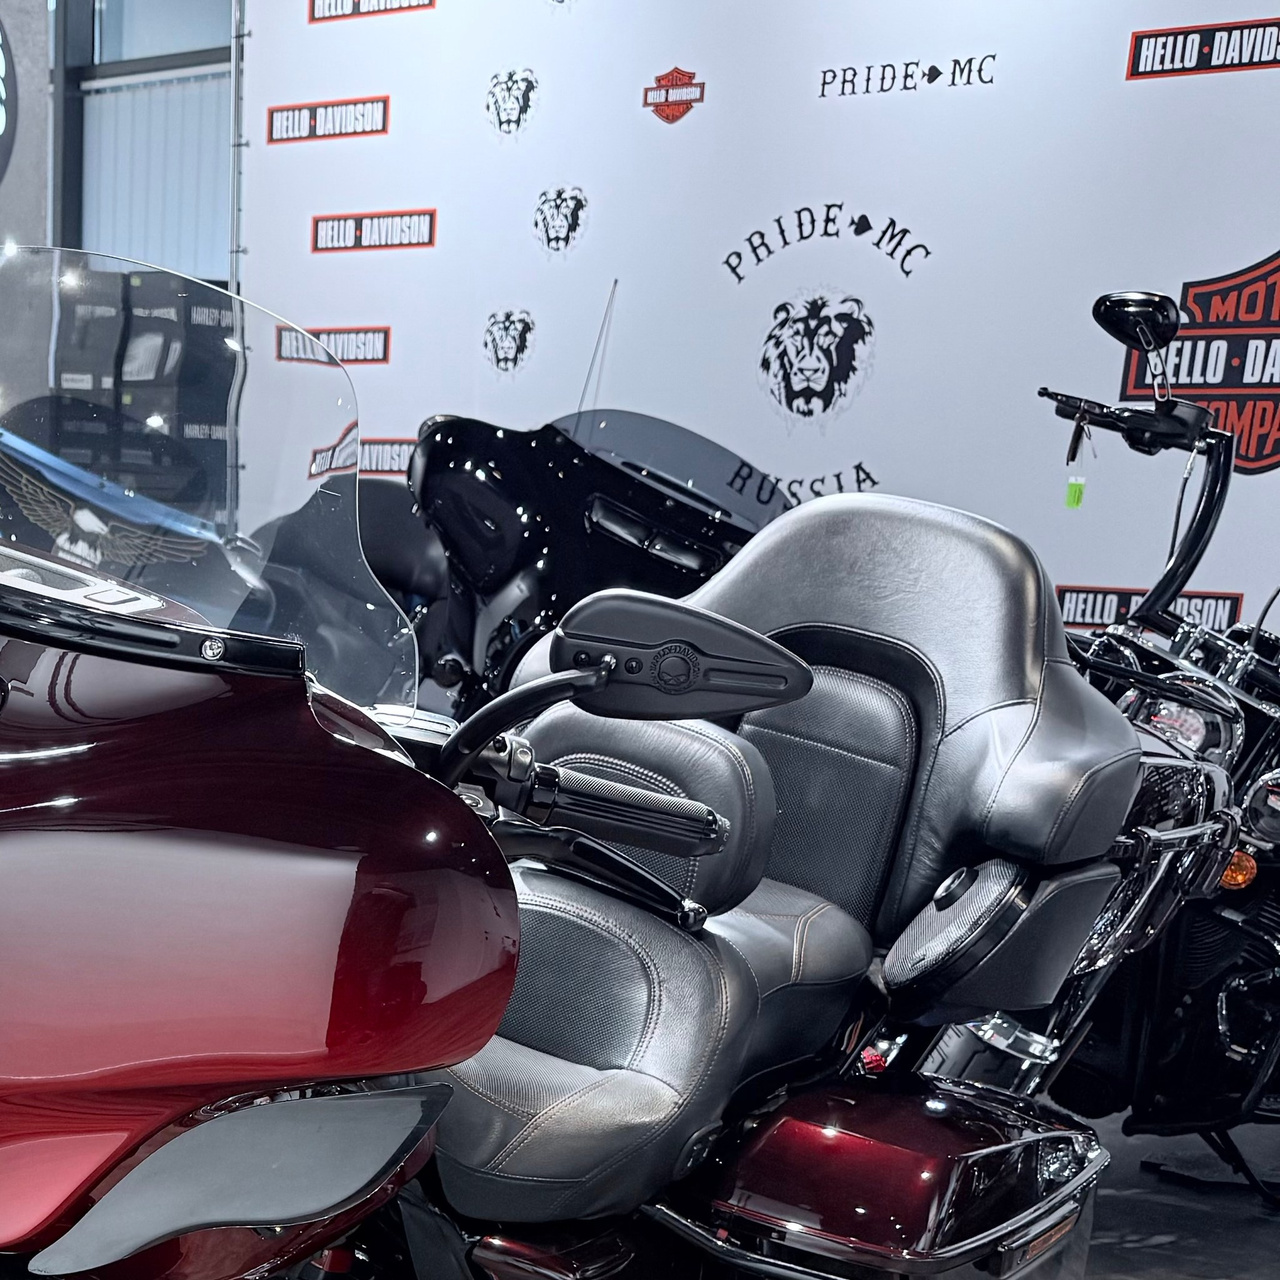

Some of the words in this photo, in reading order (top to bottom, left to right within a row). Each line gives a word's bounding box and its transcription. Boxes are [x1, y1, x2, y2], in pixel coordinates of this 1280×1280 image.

[1138, 33, 1201, 72] HELLO
[818, 60, 920, 98] PRIDE
[947, 53, 997, 87] MC
[272, 108, 310, 140] HELLO
[315, 101, 384, 136] DAVIDSON
[317, 218, 356, 249] HELLO
[361, 213, 431, 246] DAVIDSON
[722, 201, 844, 284] PRIDE
[872, 217, 931, 278] MC
[1062, 592, 1119, 624] HELLO
